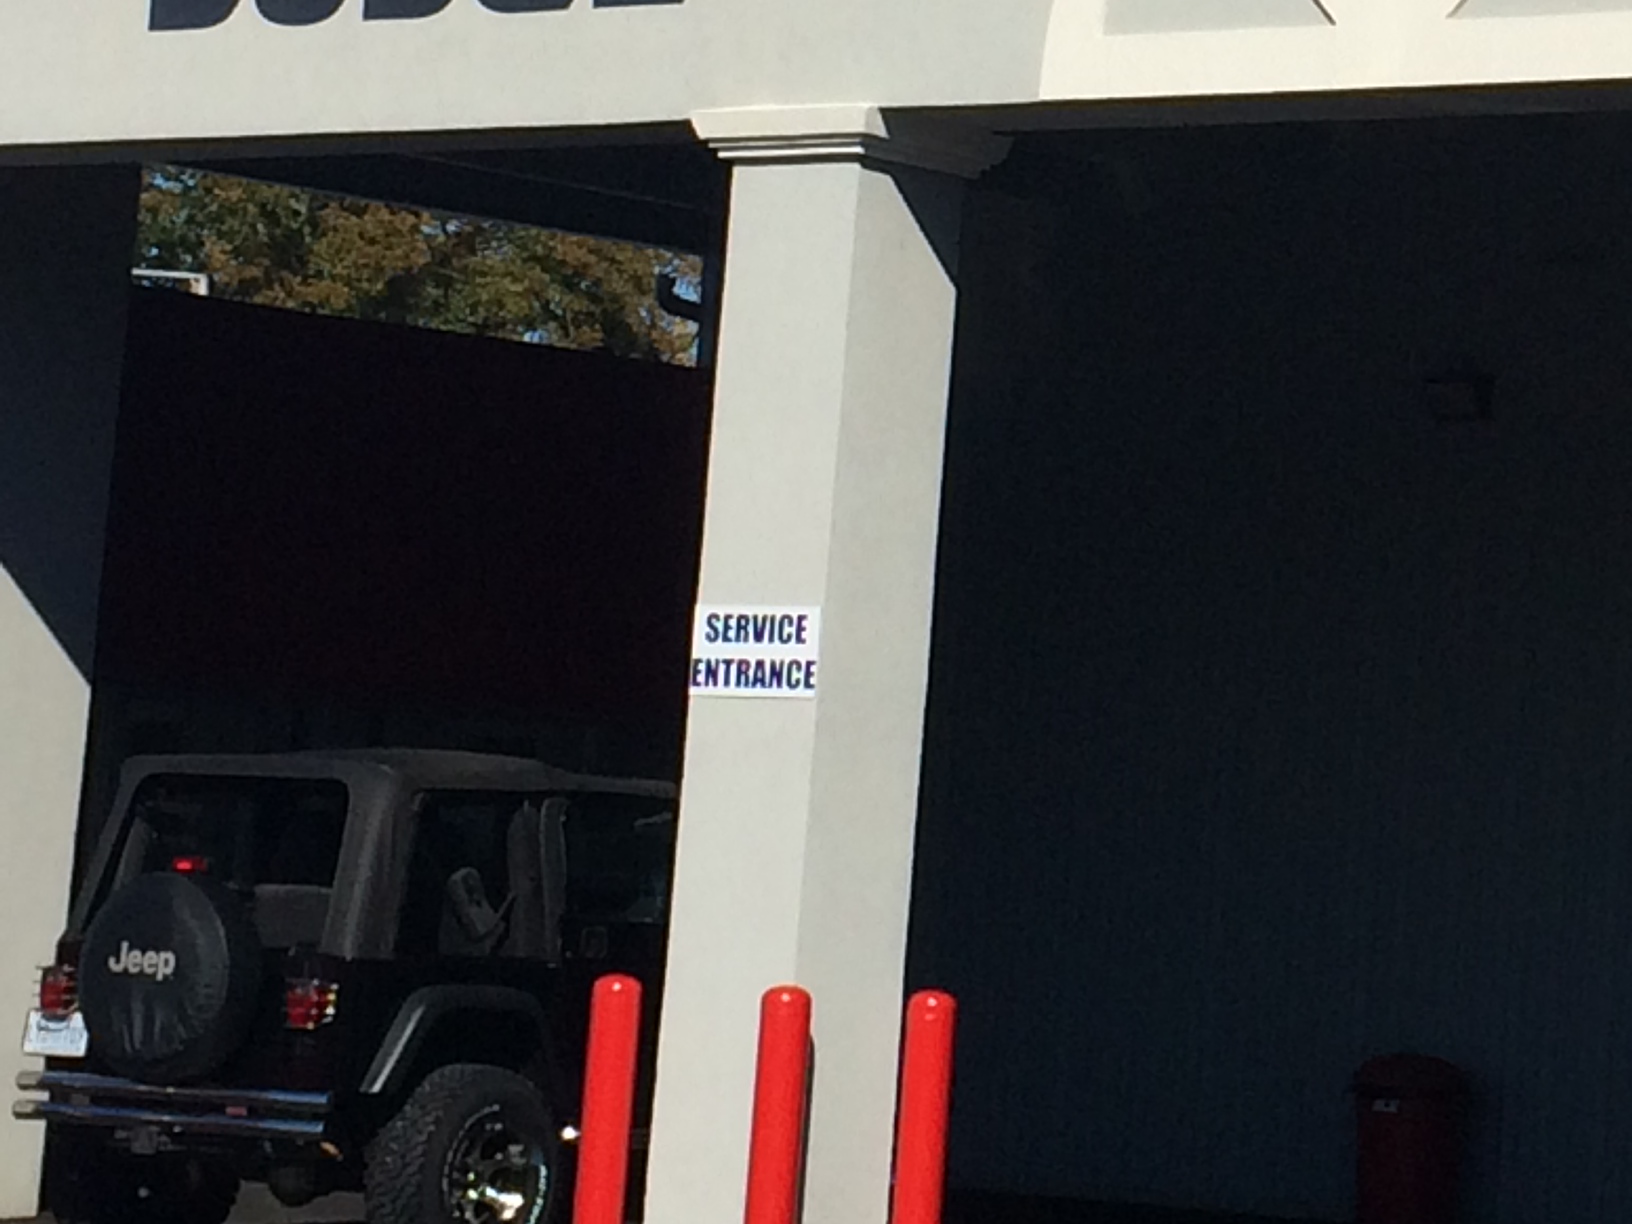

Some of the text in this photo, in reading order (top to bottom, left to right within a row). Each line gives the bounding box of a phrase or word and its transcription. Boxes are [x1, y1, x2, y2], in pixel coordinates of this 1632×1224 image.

[704, 612, 809, 645] SERVICE
[690, 657, 818, 690] ENTRANCE
[107, 940, 177, 982] Jeep
